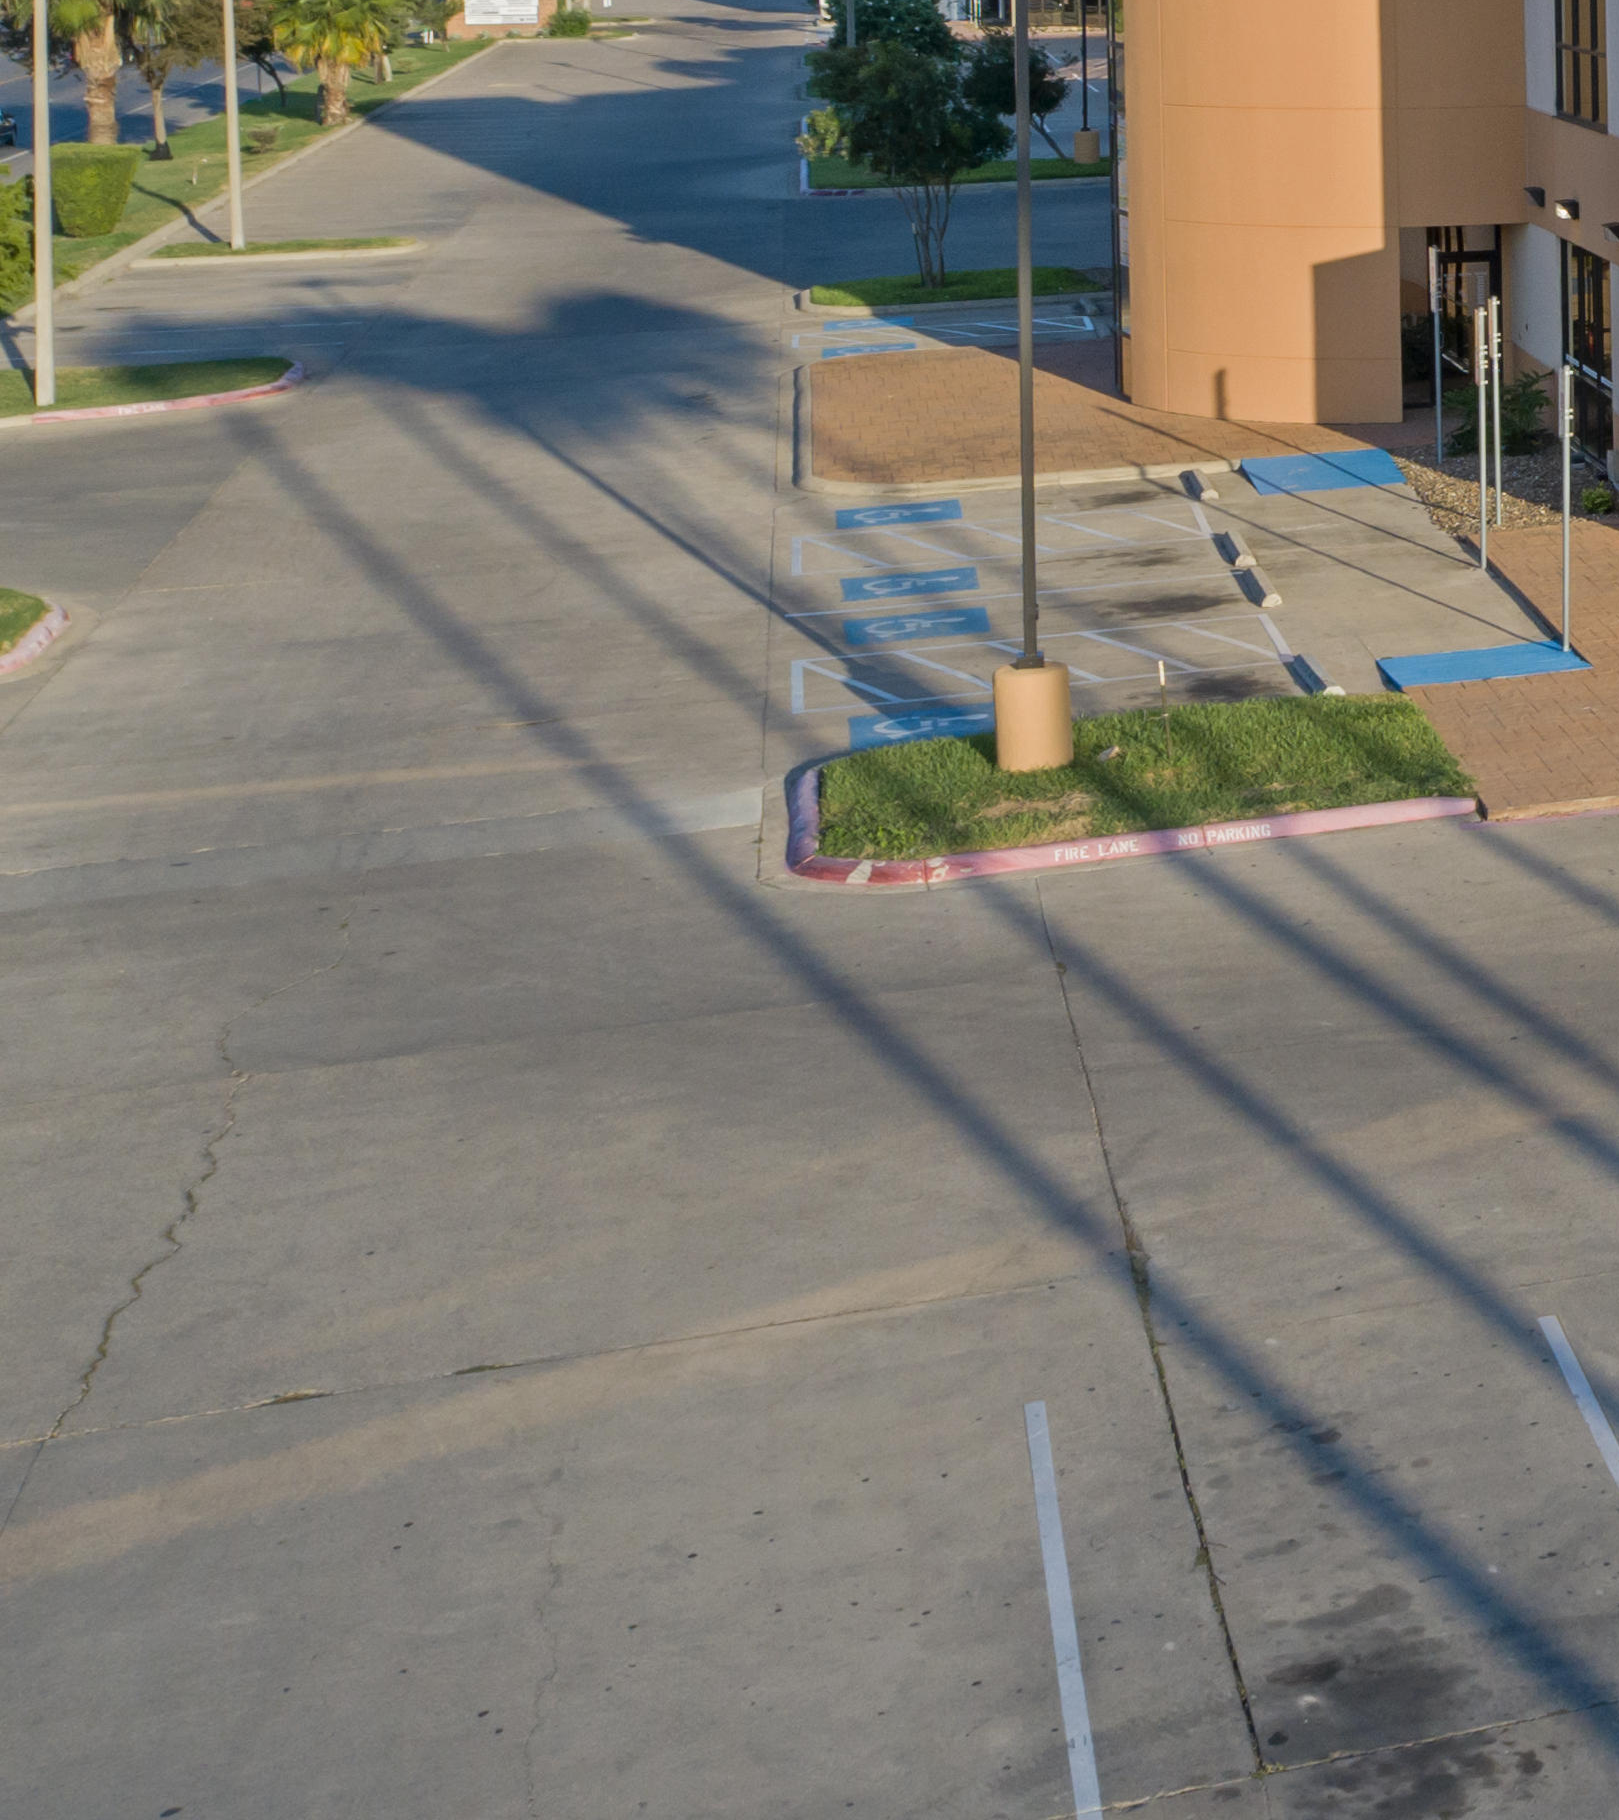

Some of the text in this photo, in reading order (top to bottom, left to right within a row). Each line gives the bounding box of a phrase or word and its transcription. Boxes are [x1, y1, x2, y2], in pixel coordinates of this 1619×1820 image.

[1177, 824, 1272, 847] NO PARKING
[1054, 839, 1139, 862] FIRE LANE
